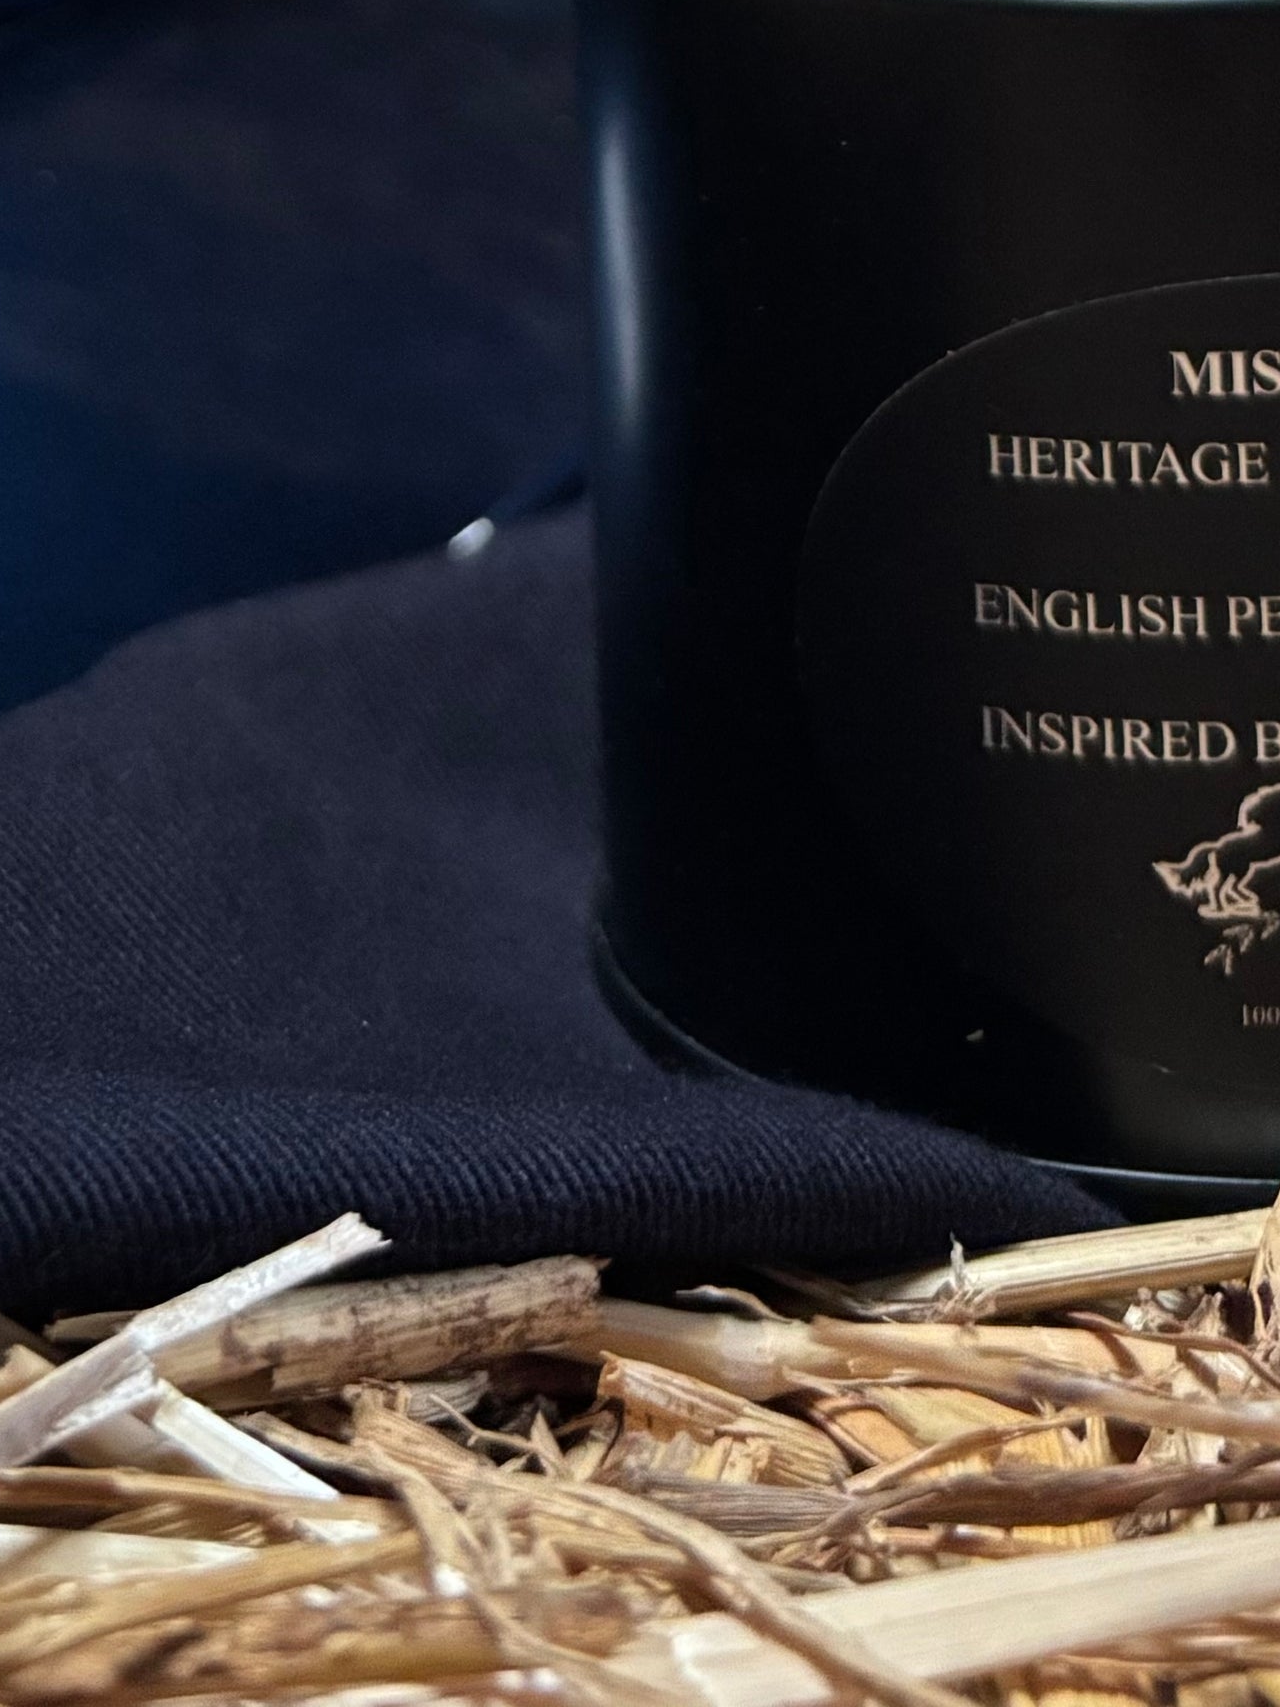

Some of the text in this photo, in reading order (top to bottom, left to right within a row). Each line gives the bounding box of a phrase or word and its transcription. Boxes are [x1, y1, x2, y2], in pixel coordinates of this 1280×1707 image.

[987, 433, 1269, 486] HERITAGE
[974, 583, 1208, 639] ENGLISH
[982, 706, 1236, 763] INSPIRED
